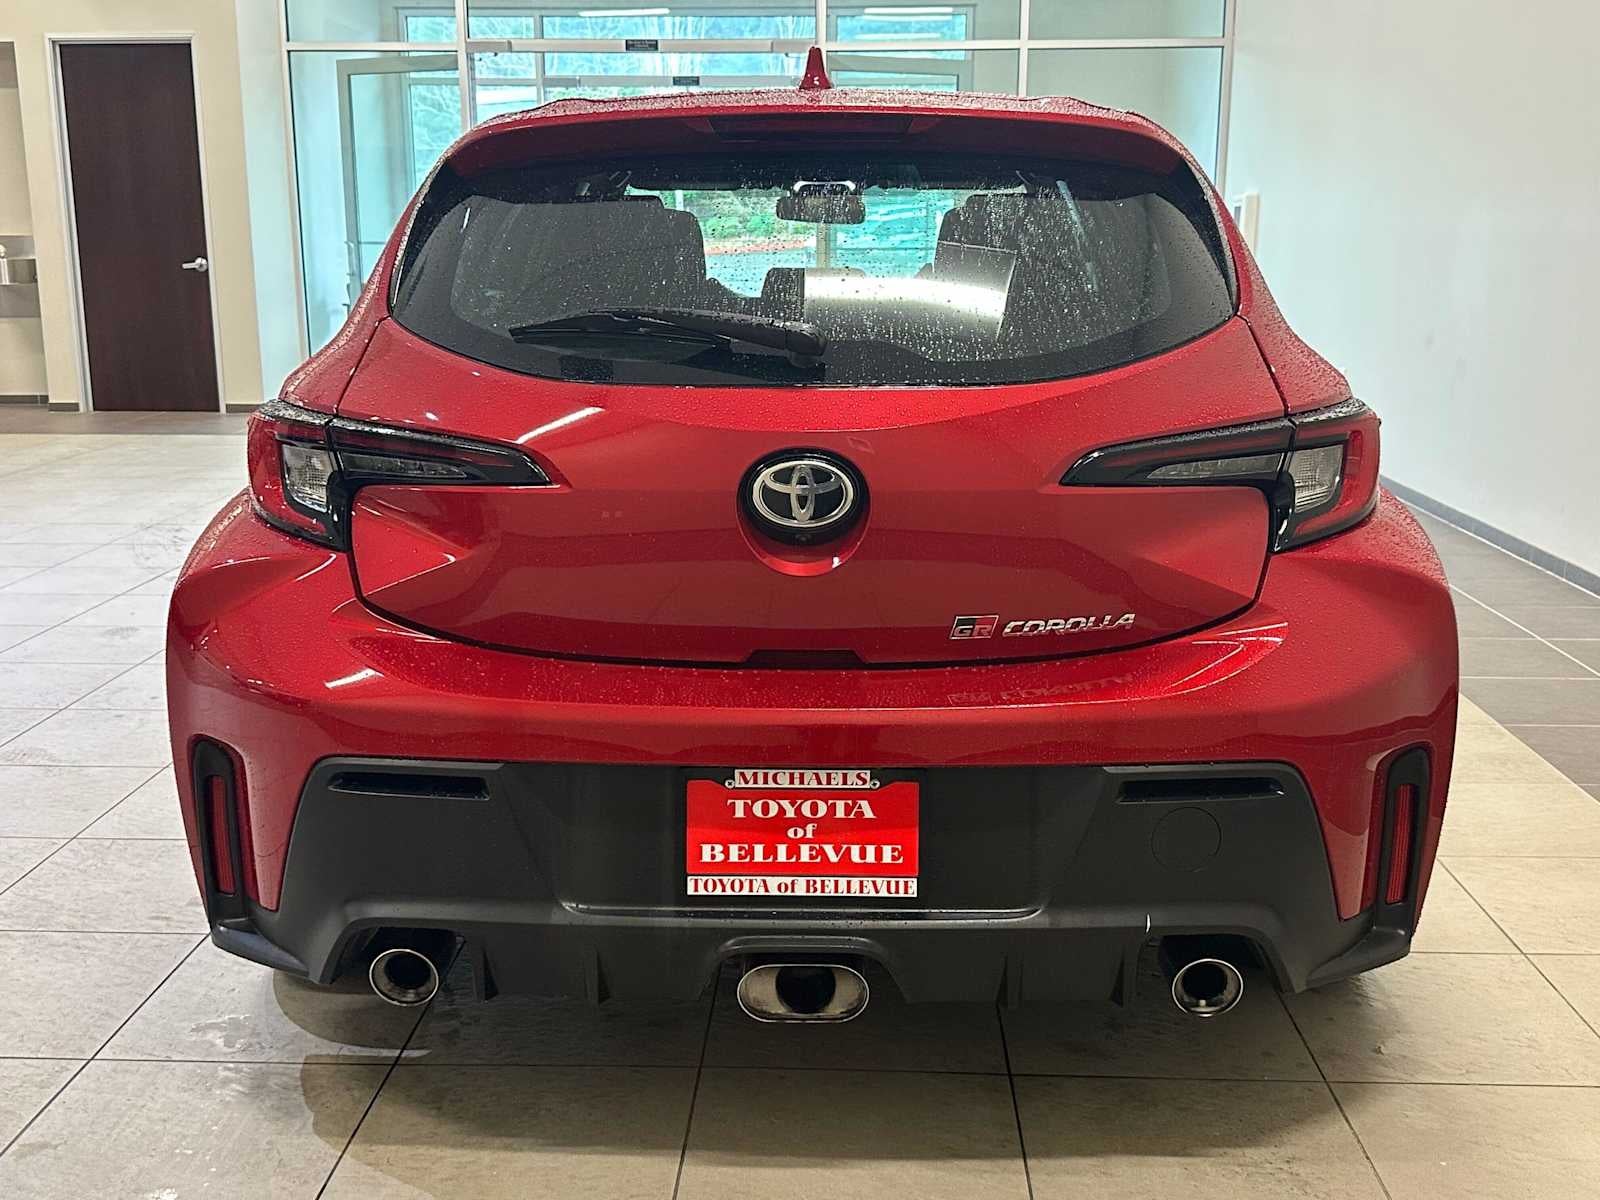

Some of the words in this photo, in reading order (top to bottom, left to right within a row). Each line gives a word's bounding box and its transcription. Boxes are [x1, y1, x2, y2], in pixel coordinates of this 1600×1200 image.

[1002, 613, 1135, 637] COROLLA
[738, 771, 868, 786] MICHAELS
[727, 799, 876, 818] TOYOTA
[787, 823, 817, 839] of
[700, 844, 903, 864] BELLEVUE
[690, 878, 769, 893] TOYOTA
[777, 879, 798, 893] of
[805, 879, 915, 895] BELLEVUE
